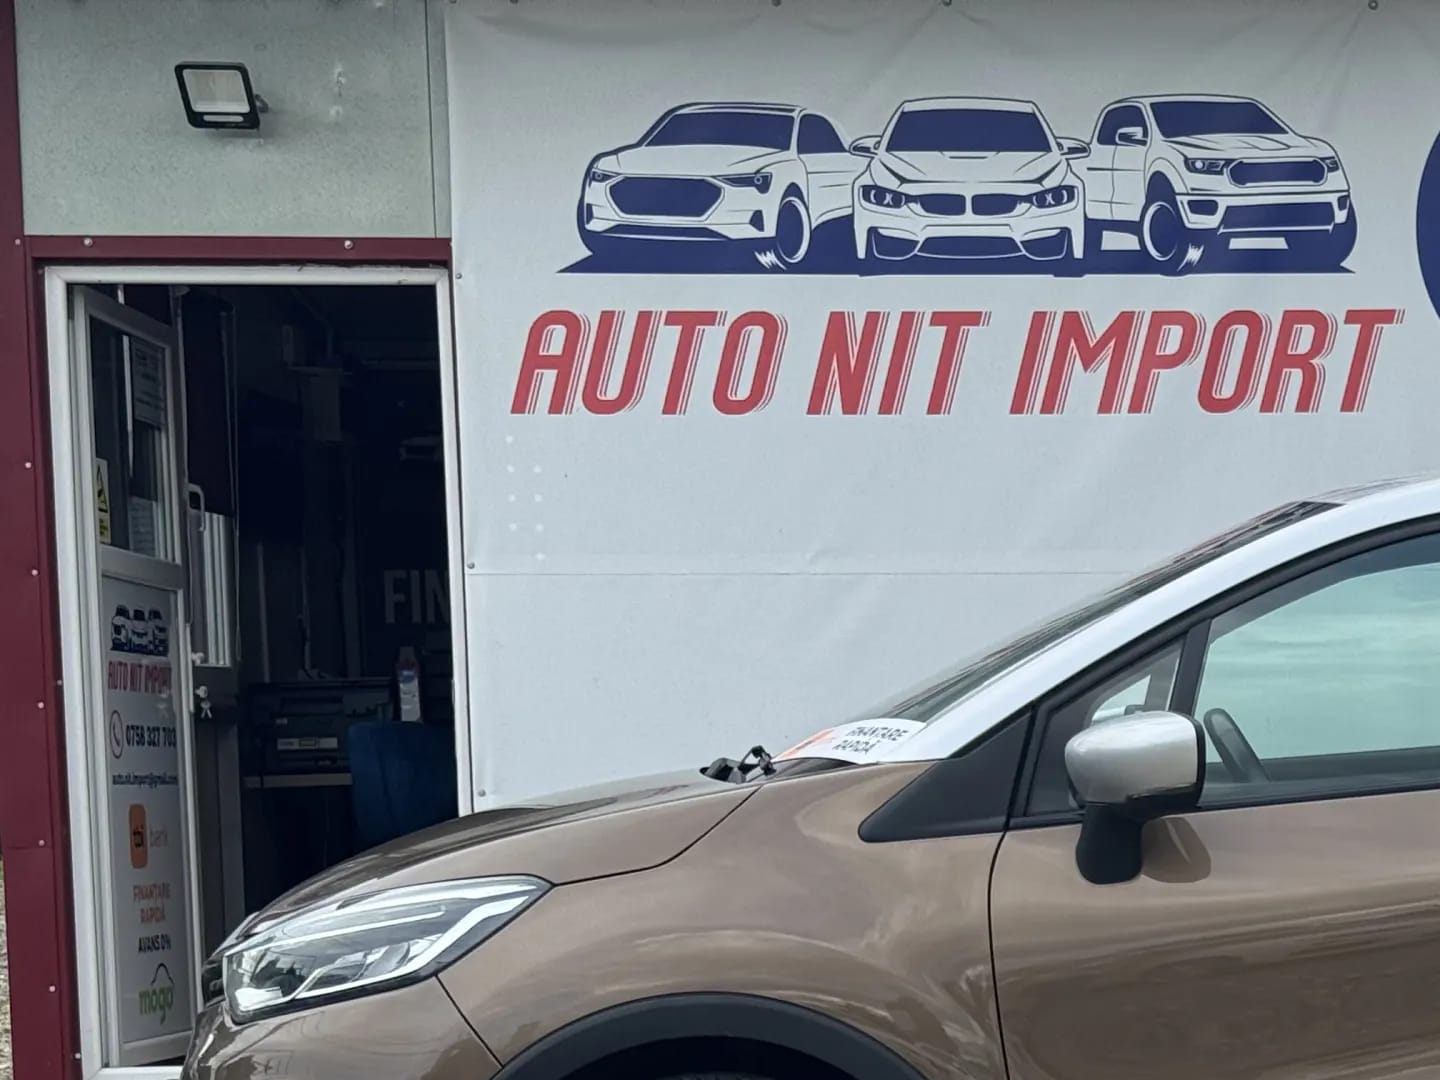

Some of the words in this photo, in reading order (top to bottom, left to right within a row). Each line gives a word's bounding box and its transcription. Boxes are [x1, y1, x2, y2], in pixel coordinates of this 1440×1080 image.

[510, 309, 788, 416] AUTO
[806, 309, 991, 416] NIT
[1008, 308, 1405, 415] IMPORT
[108, 661, 128, 690] AUTO
[130, 663, 143, 693] NIT
[126, 724, 145, 748] 0758
[147, 726, 160, 748] 327
[161, 727, 177, 749] 703
[138, 984, 174, 1026] mogo
